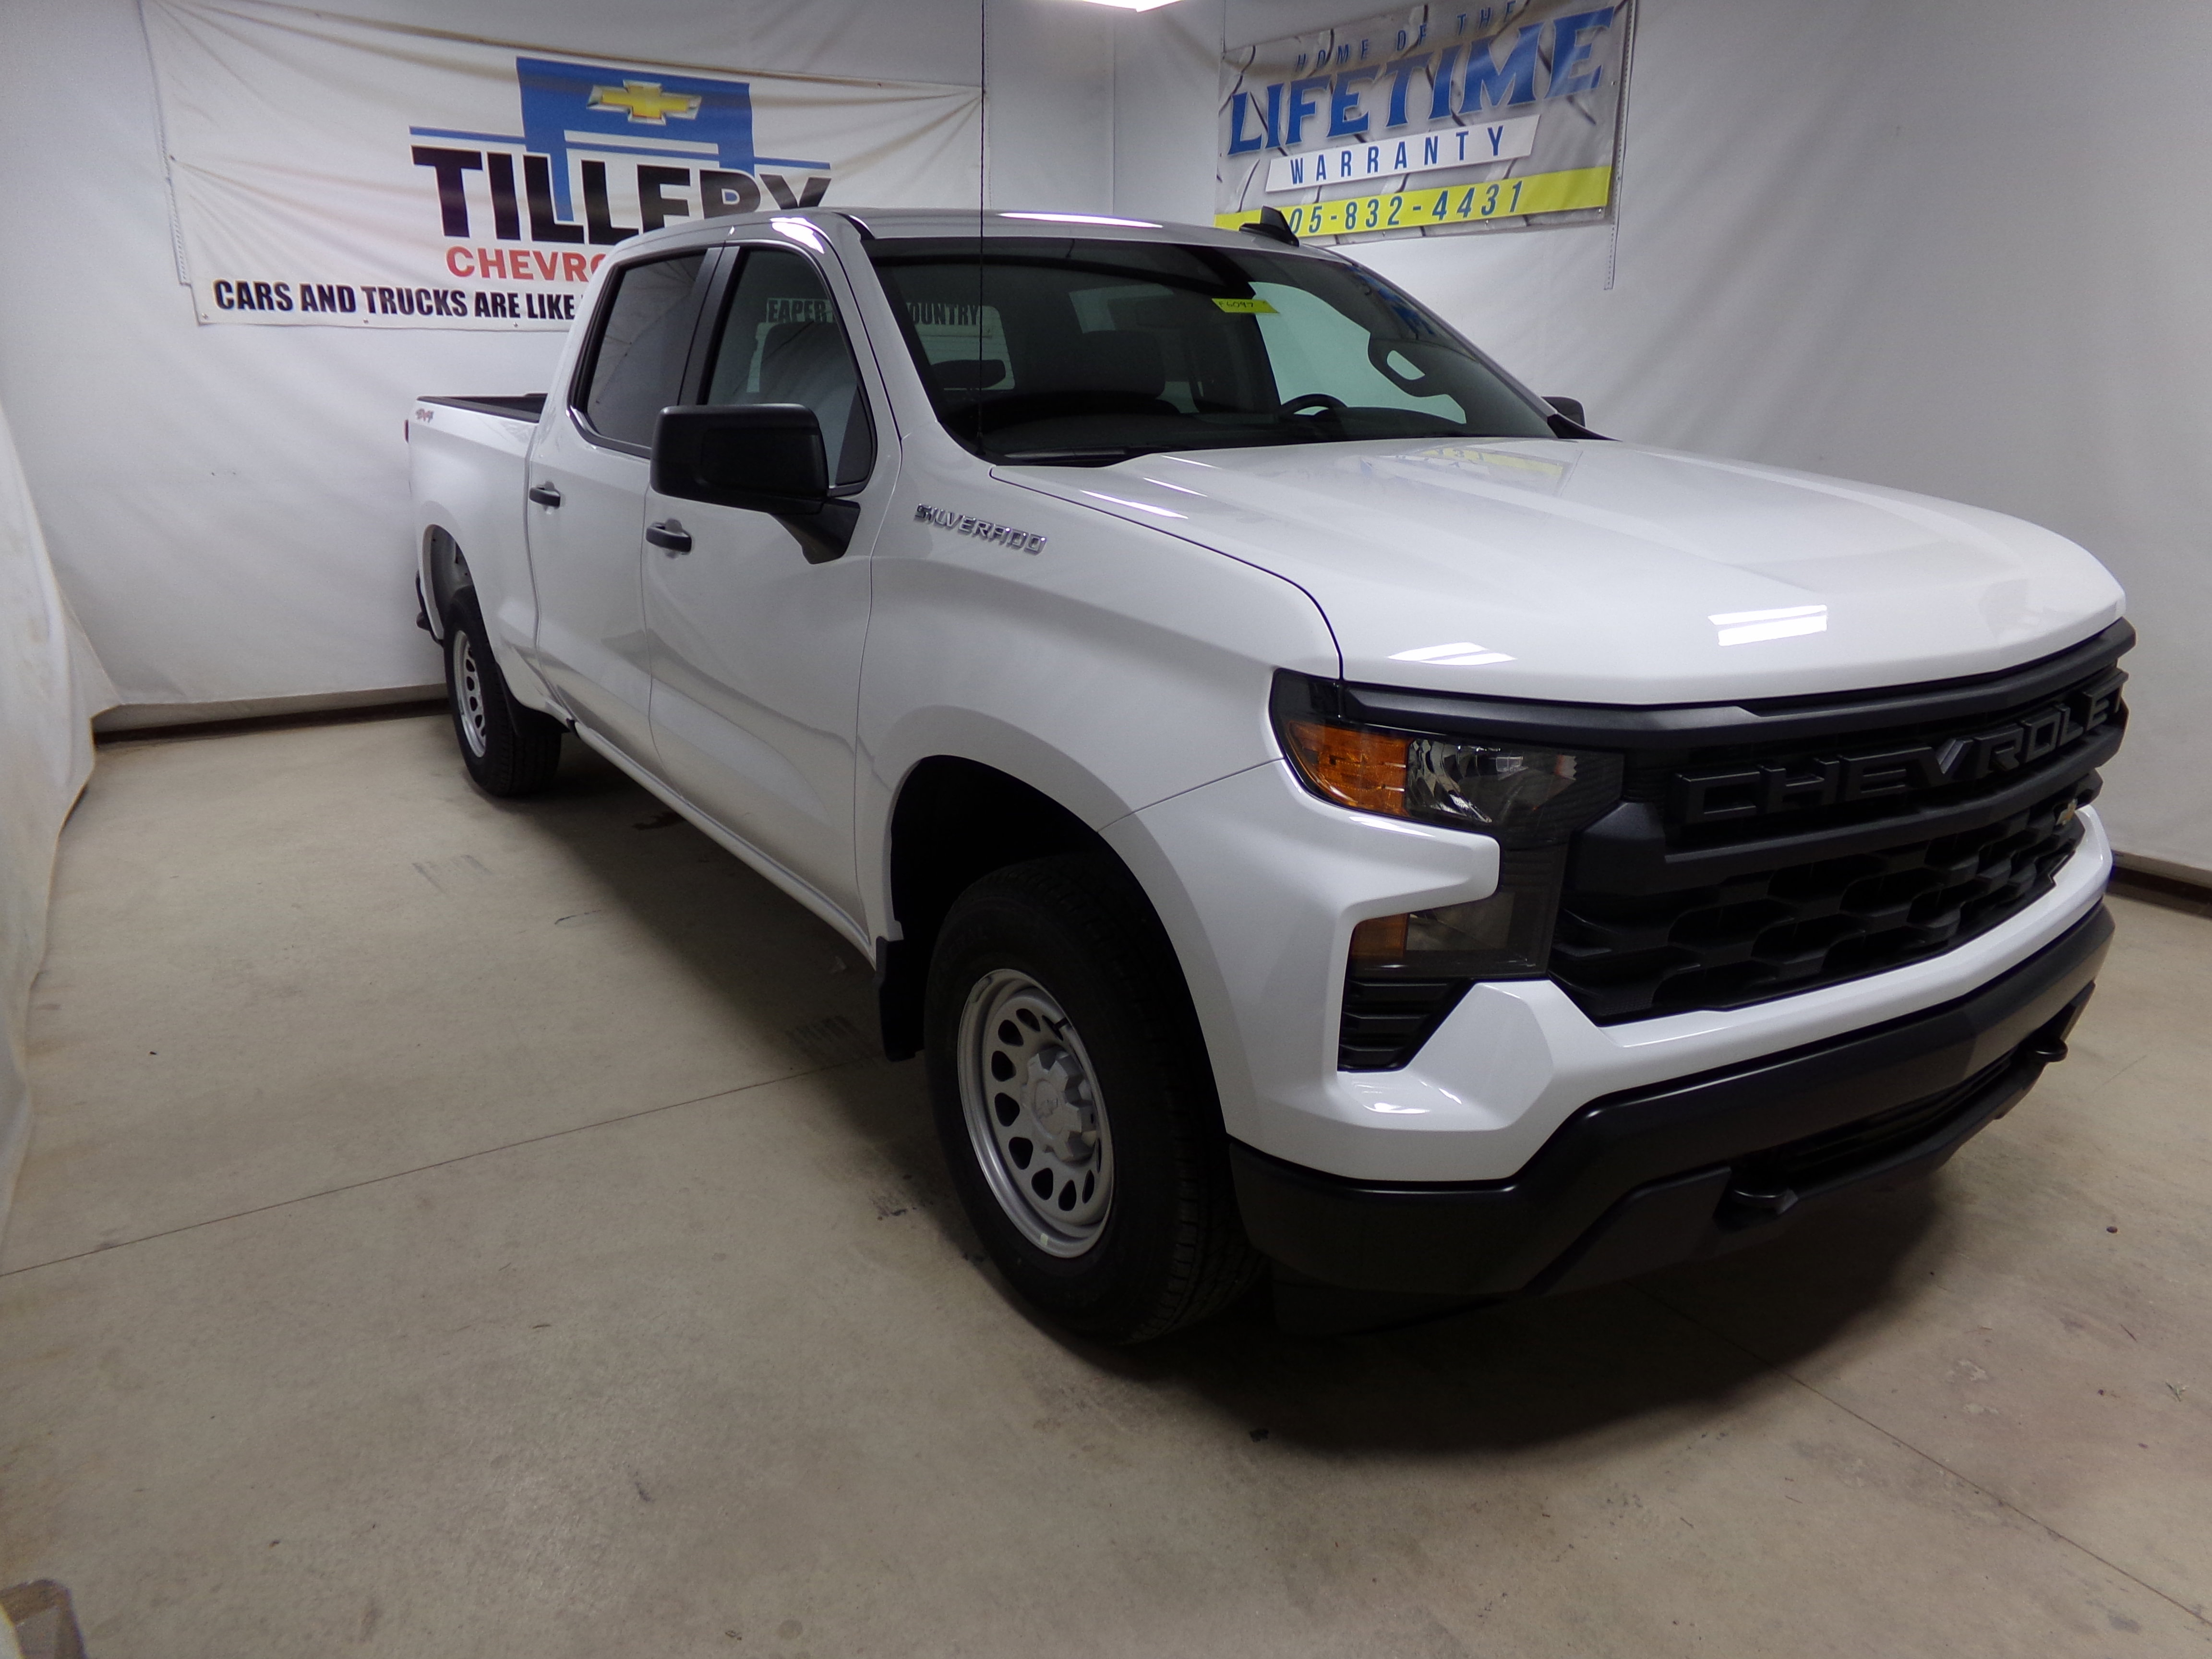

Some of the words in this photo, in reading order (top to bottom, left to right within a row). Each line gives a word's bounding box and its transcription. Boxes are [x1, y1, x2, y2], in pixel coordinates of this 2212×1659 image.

[1296, 39, 1369, 71] HOME
[1396, 24, 1427, 51] OF
[1456, 0, 1516, 36] THE
[1227, 6, 1614, 156] LIFETIME
[1290, 125, 1504, 185] WARRANTY
[1288, 180, 1523, 234] 05-832-4431
[212, 280, 292, 312] CARS
[299, 284, 357, 313] AND
[360, 286, 468, 318] TRUCKS
[474, 291, 521, 319] ARE
[526, 292, 576, 320] LIKE
[768, 299, 828, 323] EAPER
[909, 301, 979, 326] OUNTRY
[913, 503, 1047, 555] SILVERADO
